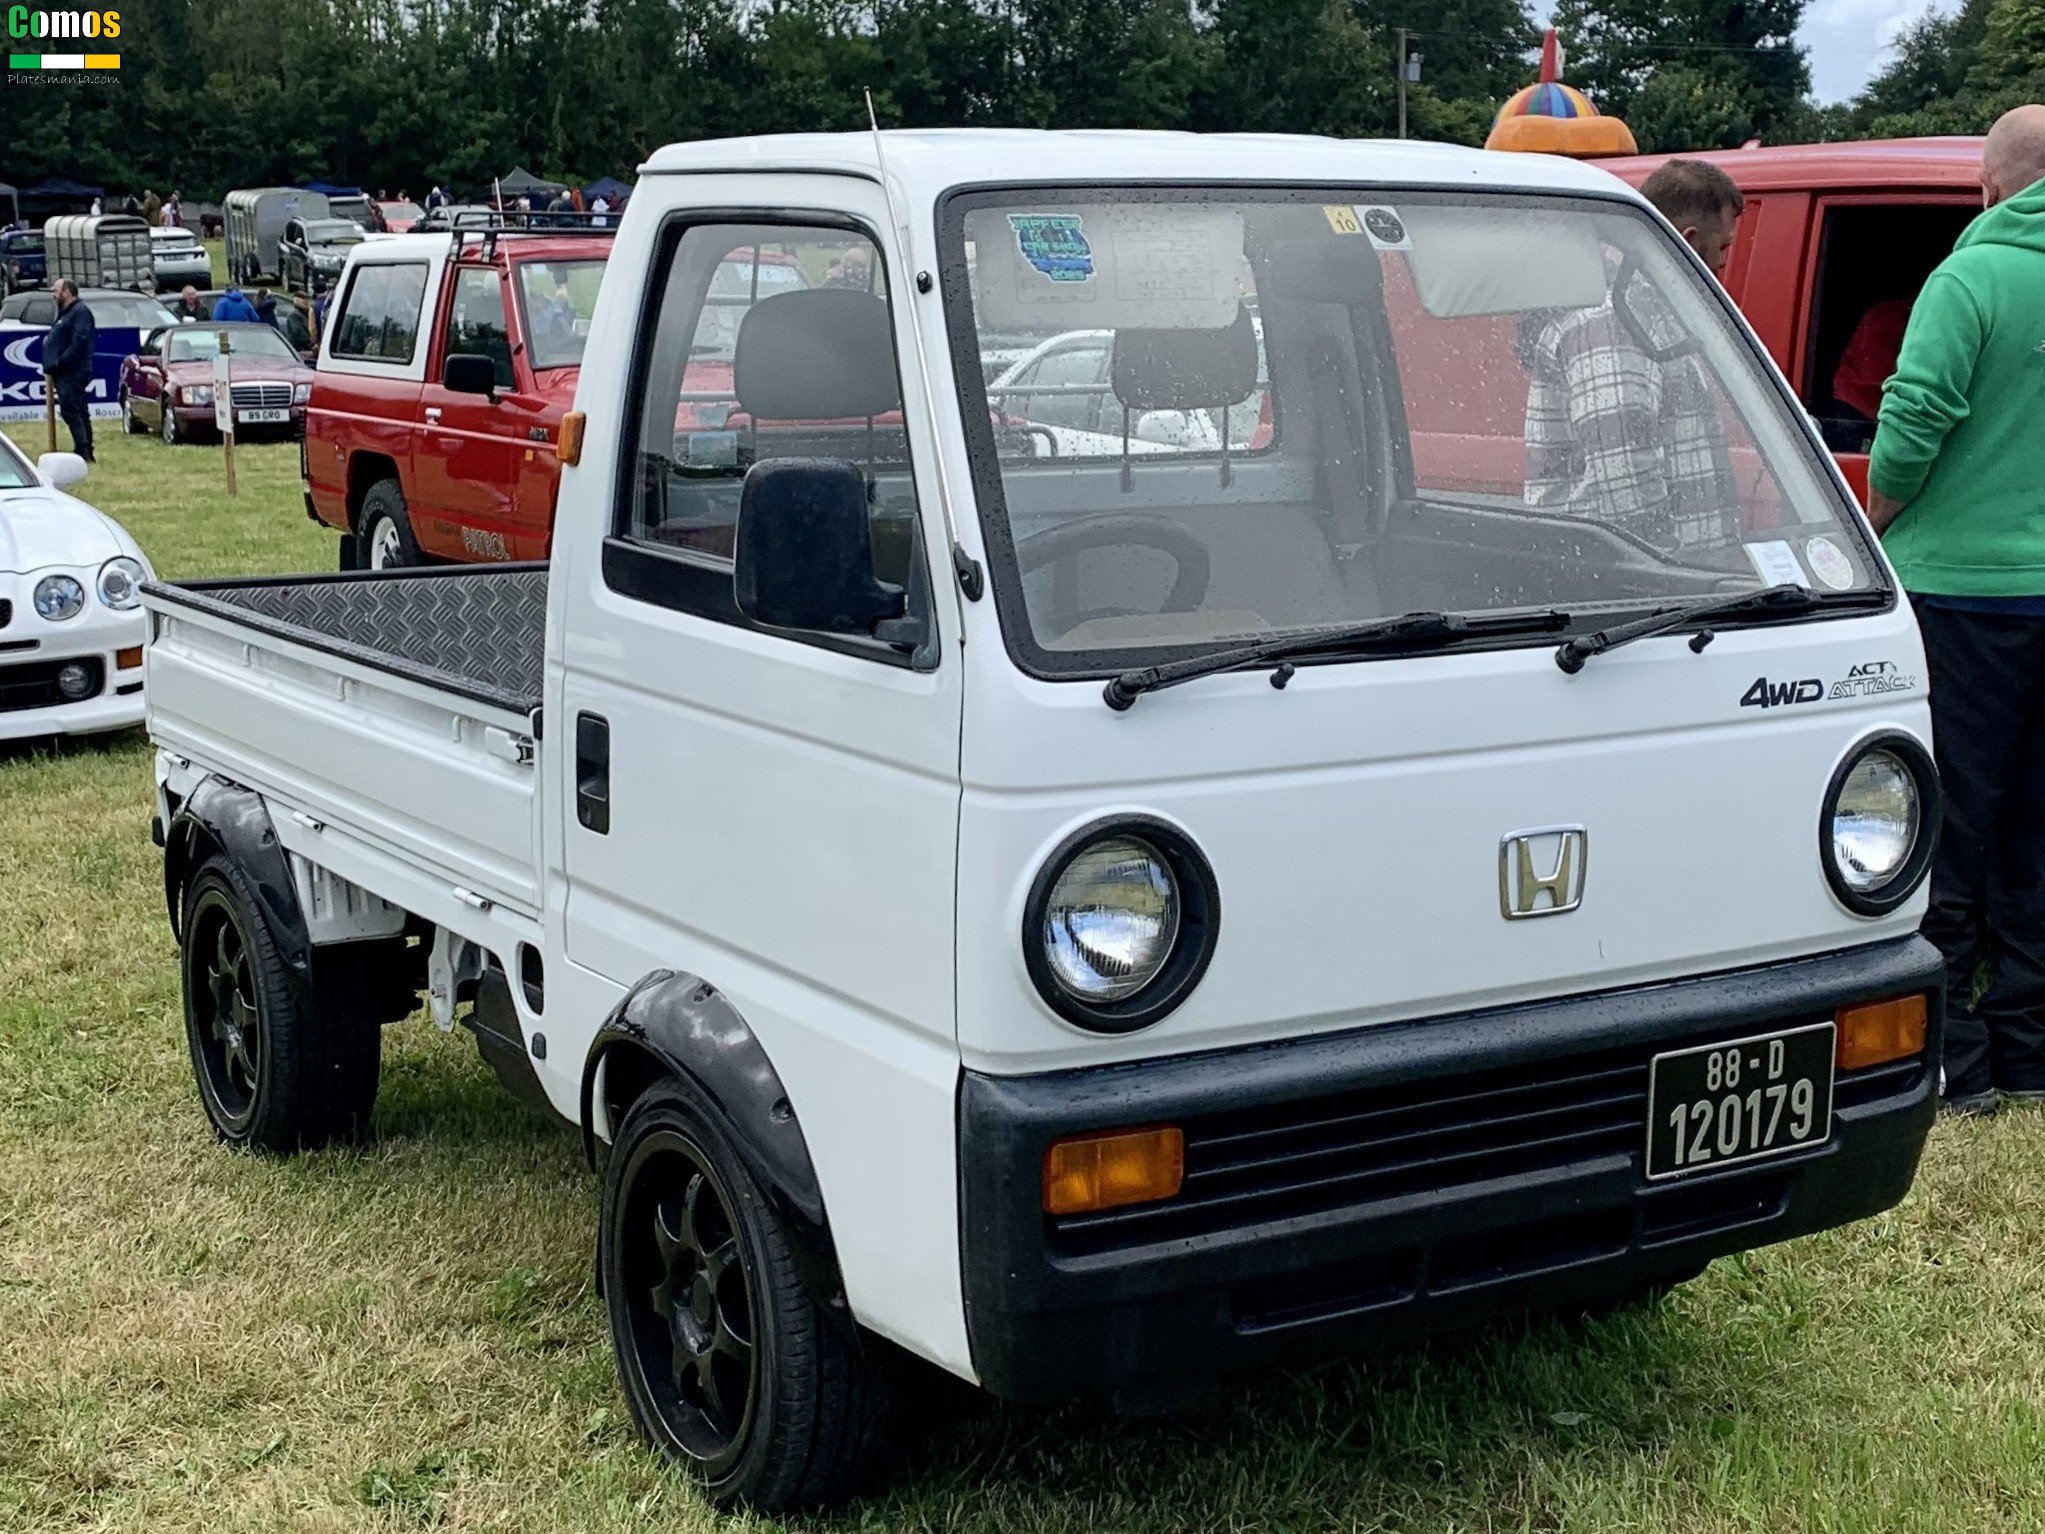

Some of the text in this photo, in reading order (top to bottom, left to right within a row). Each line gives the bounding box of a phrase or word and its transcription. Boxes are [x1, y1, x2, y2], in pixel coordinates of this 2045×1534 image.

[1335, 219, 1357, 232] 10
[0, 410, 39, 420] vailable
[95, 408, 122, 418] Roscr
[462, 525, 511, 561] PATROL
[1740, 677, 1824, 708] 4WD
[1669, 1077, 1814, 1166] 120179
